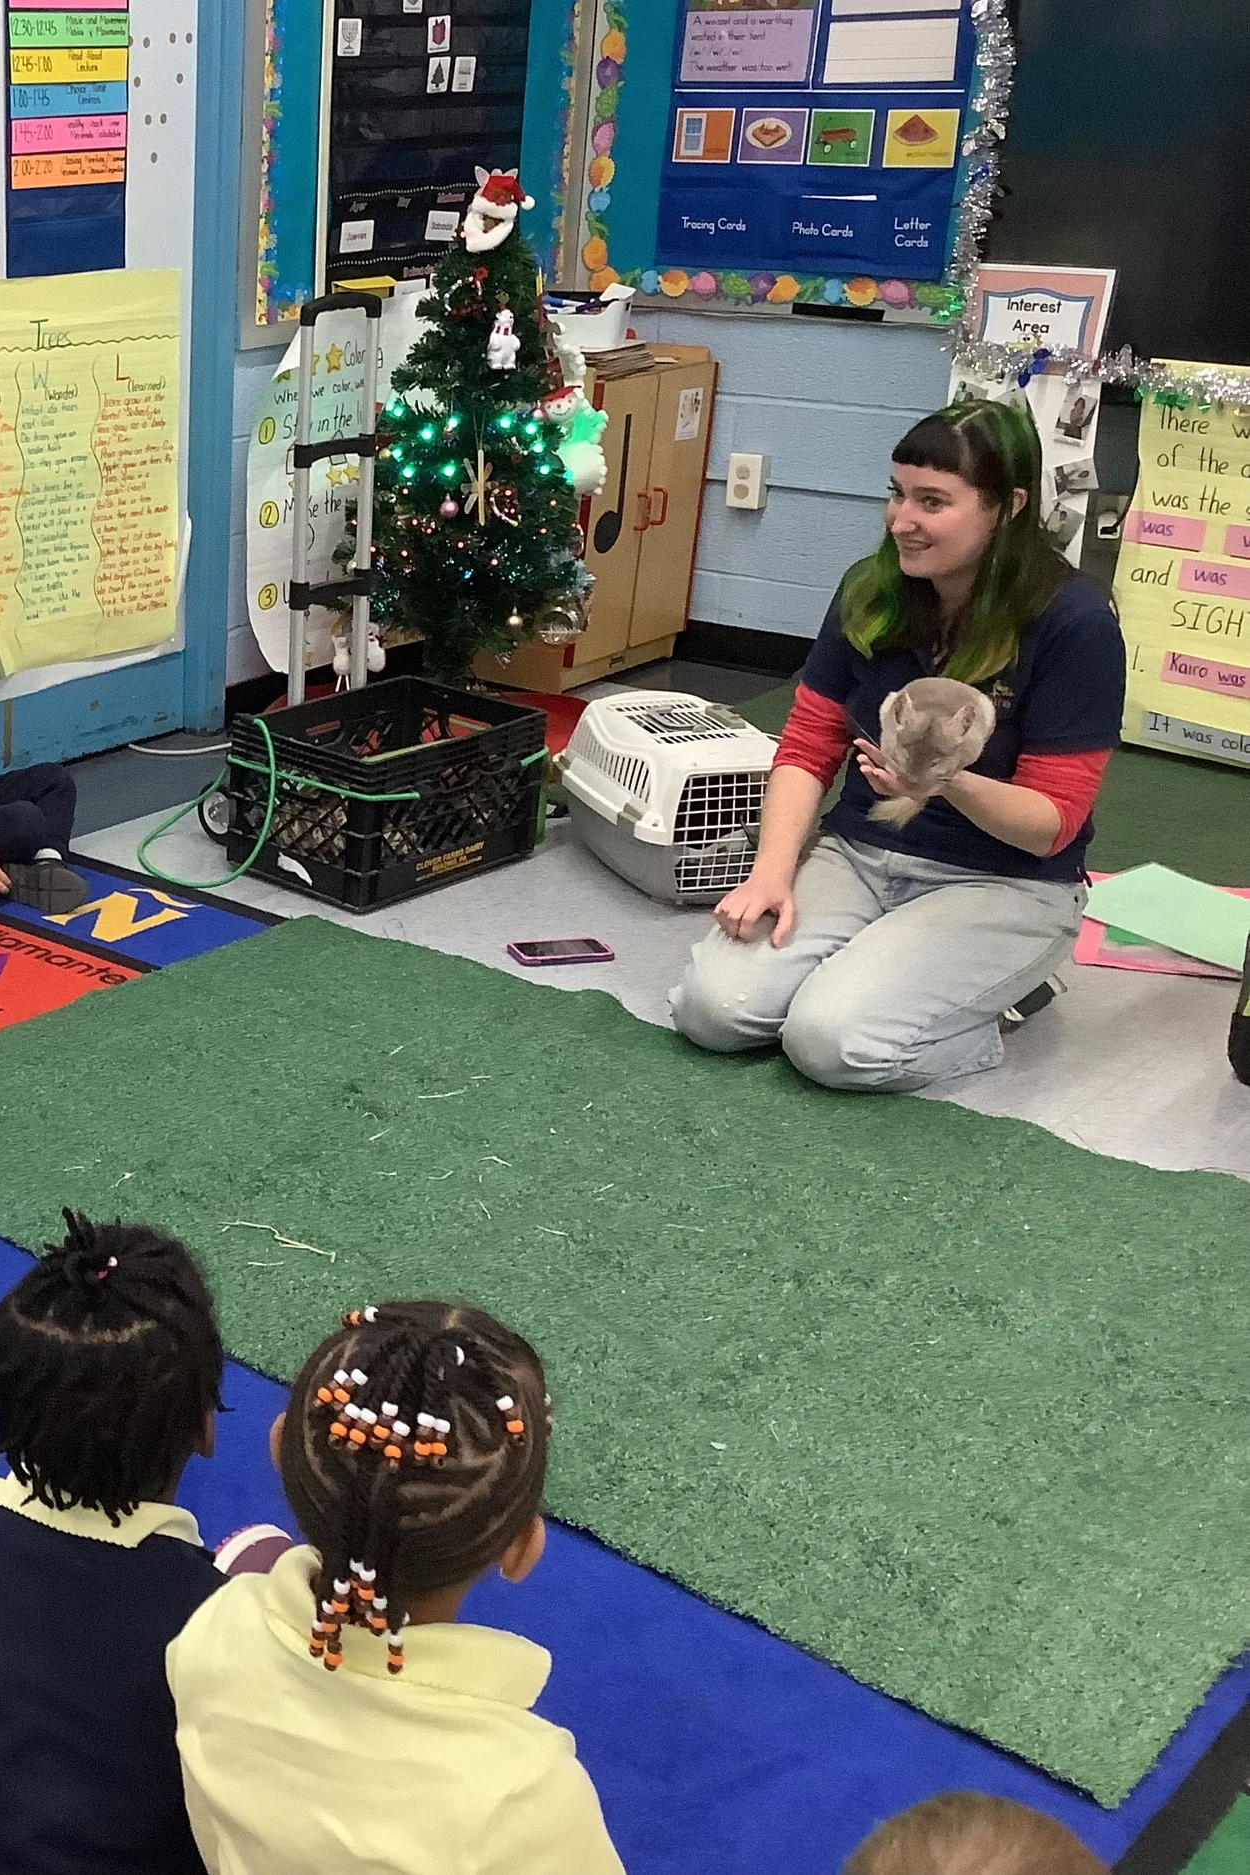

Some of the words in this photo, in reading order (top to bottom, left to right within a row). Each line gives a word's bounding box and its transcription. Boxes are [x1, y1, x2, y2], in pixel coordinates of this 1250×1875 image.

[693, 15, 702, 26] A
[733, 14, 749, 25] and
[706, 61, 737, 71] weather
[681, 216, 715, 235] Tracing
[717, 218, 747, 231] Cards
[792, 222, 819, 236] Photo
[821, 224, 854, 238] Cards
[894, 217, 932, 231] Letter
[894, 234, 930, 248] Cards
[1006, 297, 1062, 315] Interest
[29, 318, 72, 350] Trees
[1012, 319, 1050, 335] Area
[32, 359, 50, 390] W
[116, 353, 131, 381] L
[273, 389, 299, 405] Whe
[333, 402, 354, 431] the
[1161, 404, 1211, 436] There
[1156, 443, 1184, 468] of
[1197, 446, 1230, 475] the
[265, 505, 273, 525] 2
[325, 490, 341, 515] the
[1152, 490, 1189, 511] was
[1198, 485, 1231, 515] the
[1141, 520, 1175, 538] was
[1130, 560, 1174, 586] and
[1194, 568, 1229, 587] was
[264, 588, 273, 607] 3
[1170, 600, 1250, 638] SIGH
[1132, 645, 1145, 673] 1.
[1170, 651, 1209, 679] Kairo
[1217, 670, 1247, 689] was
[1148, 710, 1171, 732] It
[1182, 725, 1213, 744] was
